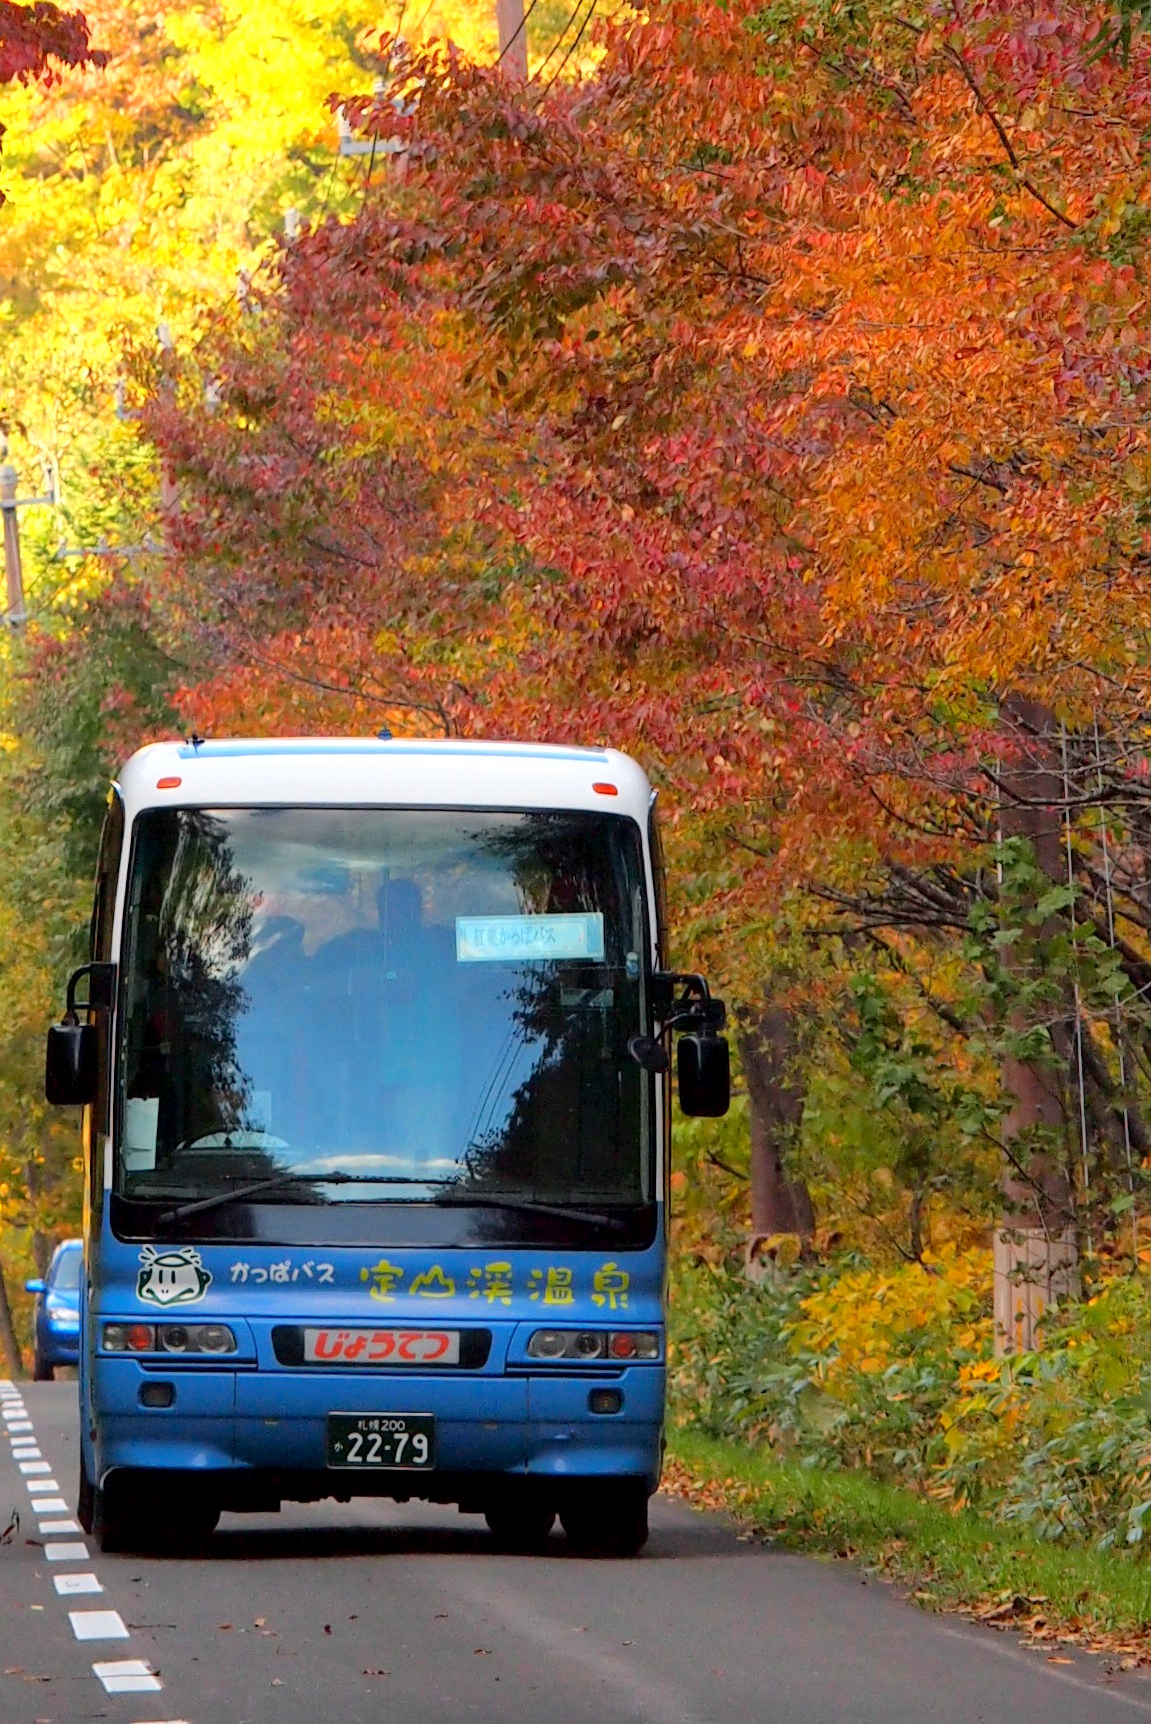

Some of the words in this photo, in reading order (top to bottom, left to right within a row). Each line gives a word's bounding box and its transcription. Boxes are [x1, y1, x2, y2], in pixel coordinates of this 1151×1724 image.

[230, 1260, 335, 1283] かっぱバス
[360, 1259, 630, 1310] 定山渓温泉
[314, 1331, 450, 1360] じょうてつ
[347, 1432, 428, 1464] 22-79
